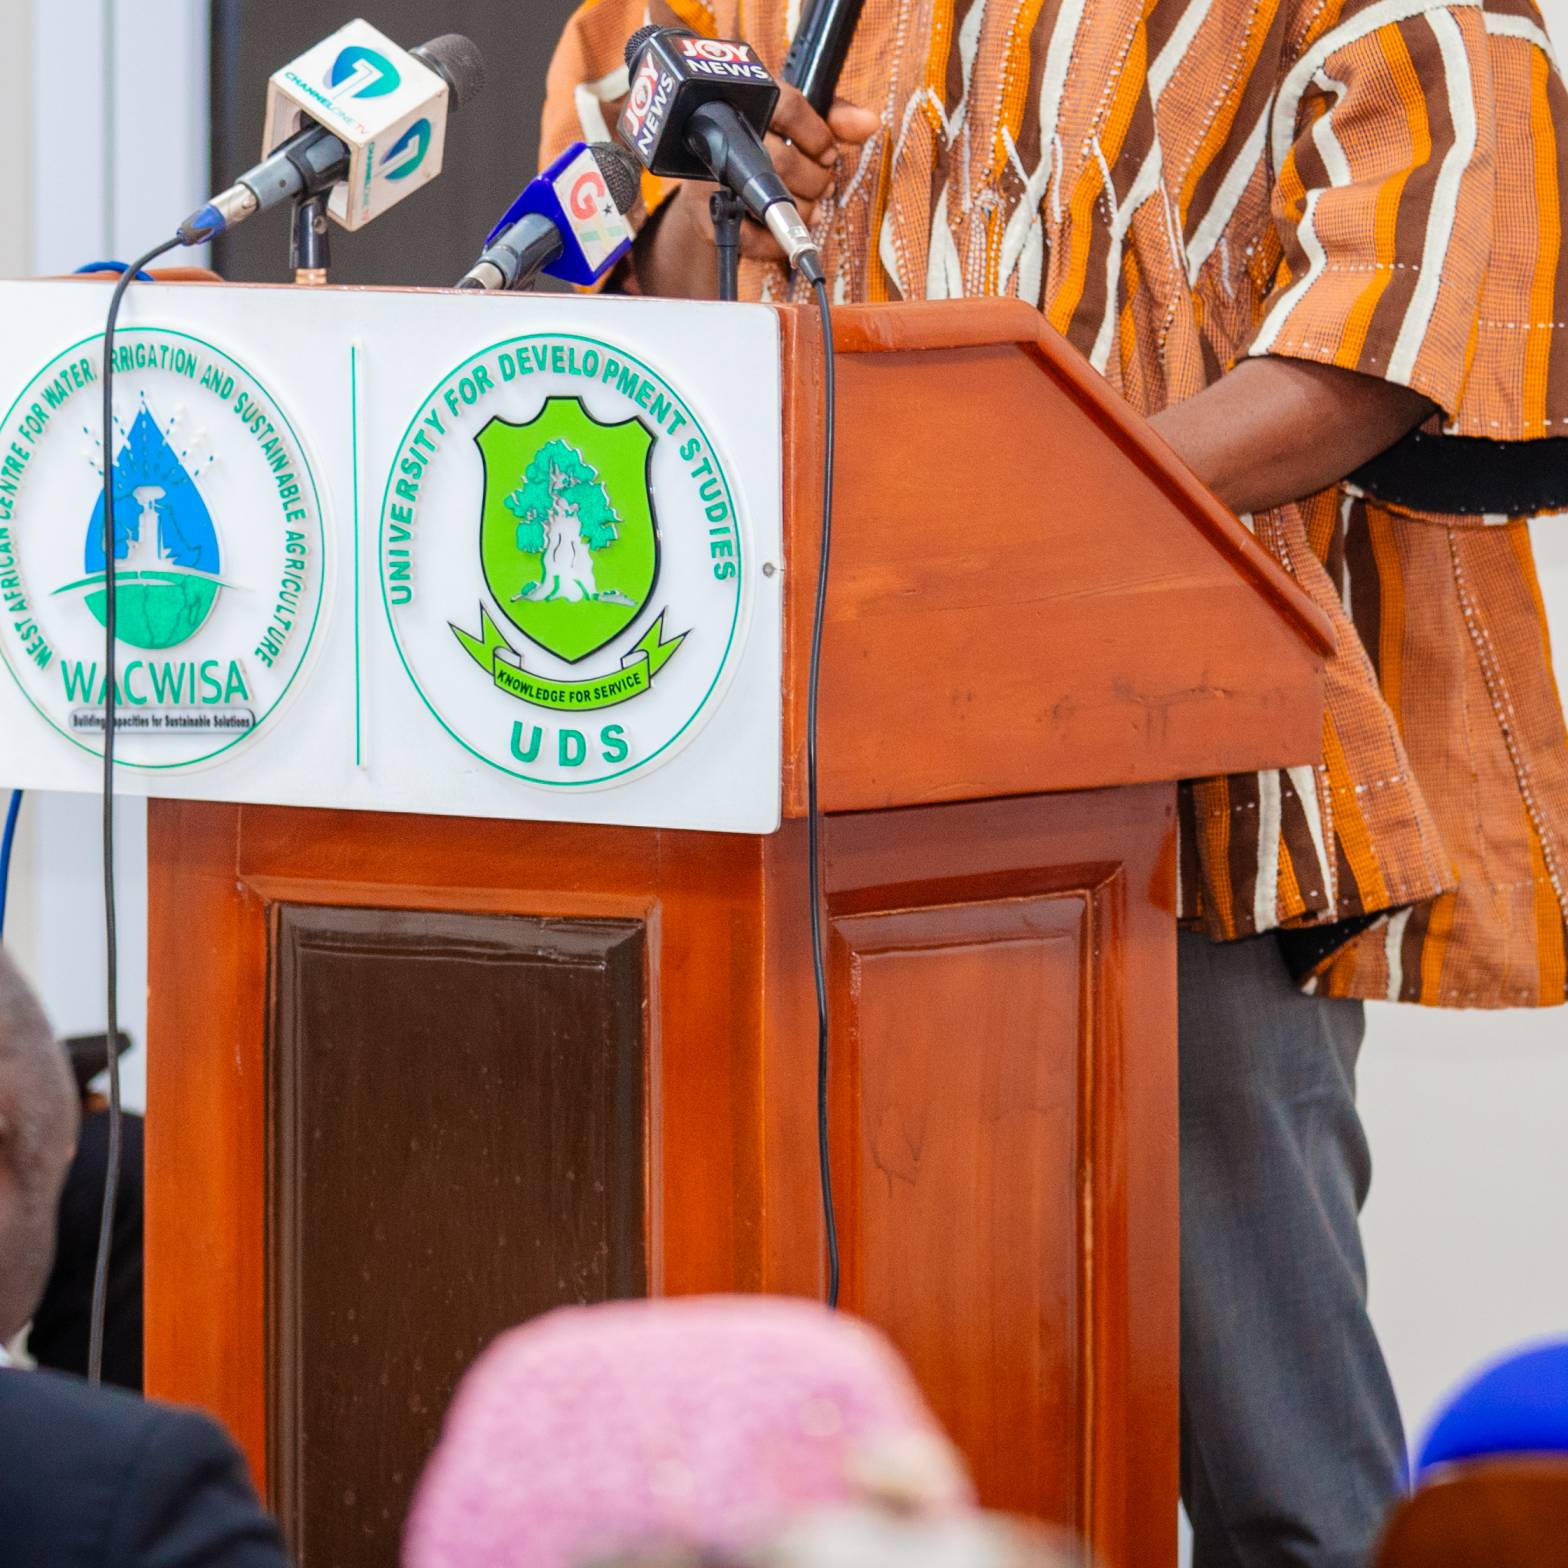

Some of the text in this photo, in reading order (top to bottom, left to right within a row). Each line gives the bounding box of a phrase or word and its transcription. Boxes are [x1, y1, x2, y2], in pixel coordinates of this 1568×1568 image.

[681, 38, 751, 62] JOY
[685, 58, 769, 80] NEWS
[625, 51, 659, 137] JOY
[637, 72, 673, 156] NEWS
[108, 342, 199, 379] RRIGATION
[199, 364, 236, 400] AND
[18, 402, 50, 445] FOR
[233, 391, 307, 523] SUSTAINABLE
[387, 344, 737, 606] UNIVERSITY FOR DEVELOPMENT STUDIES
[254, 529, 307, 669] AGRICULTURE
[13, 617, 53, 671] WEST
[59, 659, 250, 706] WACWISA
[497, 669, 642, 703] KNOWLEDGE FOR SERVICE
[73, 713, 250, 730] Building apacities for Sustainable Solutions
[510, 719, 629, 767] UDS
